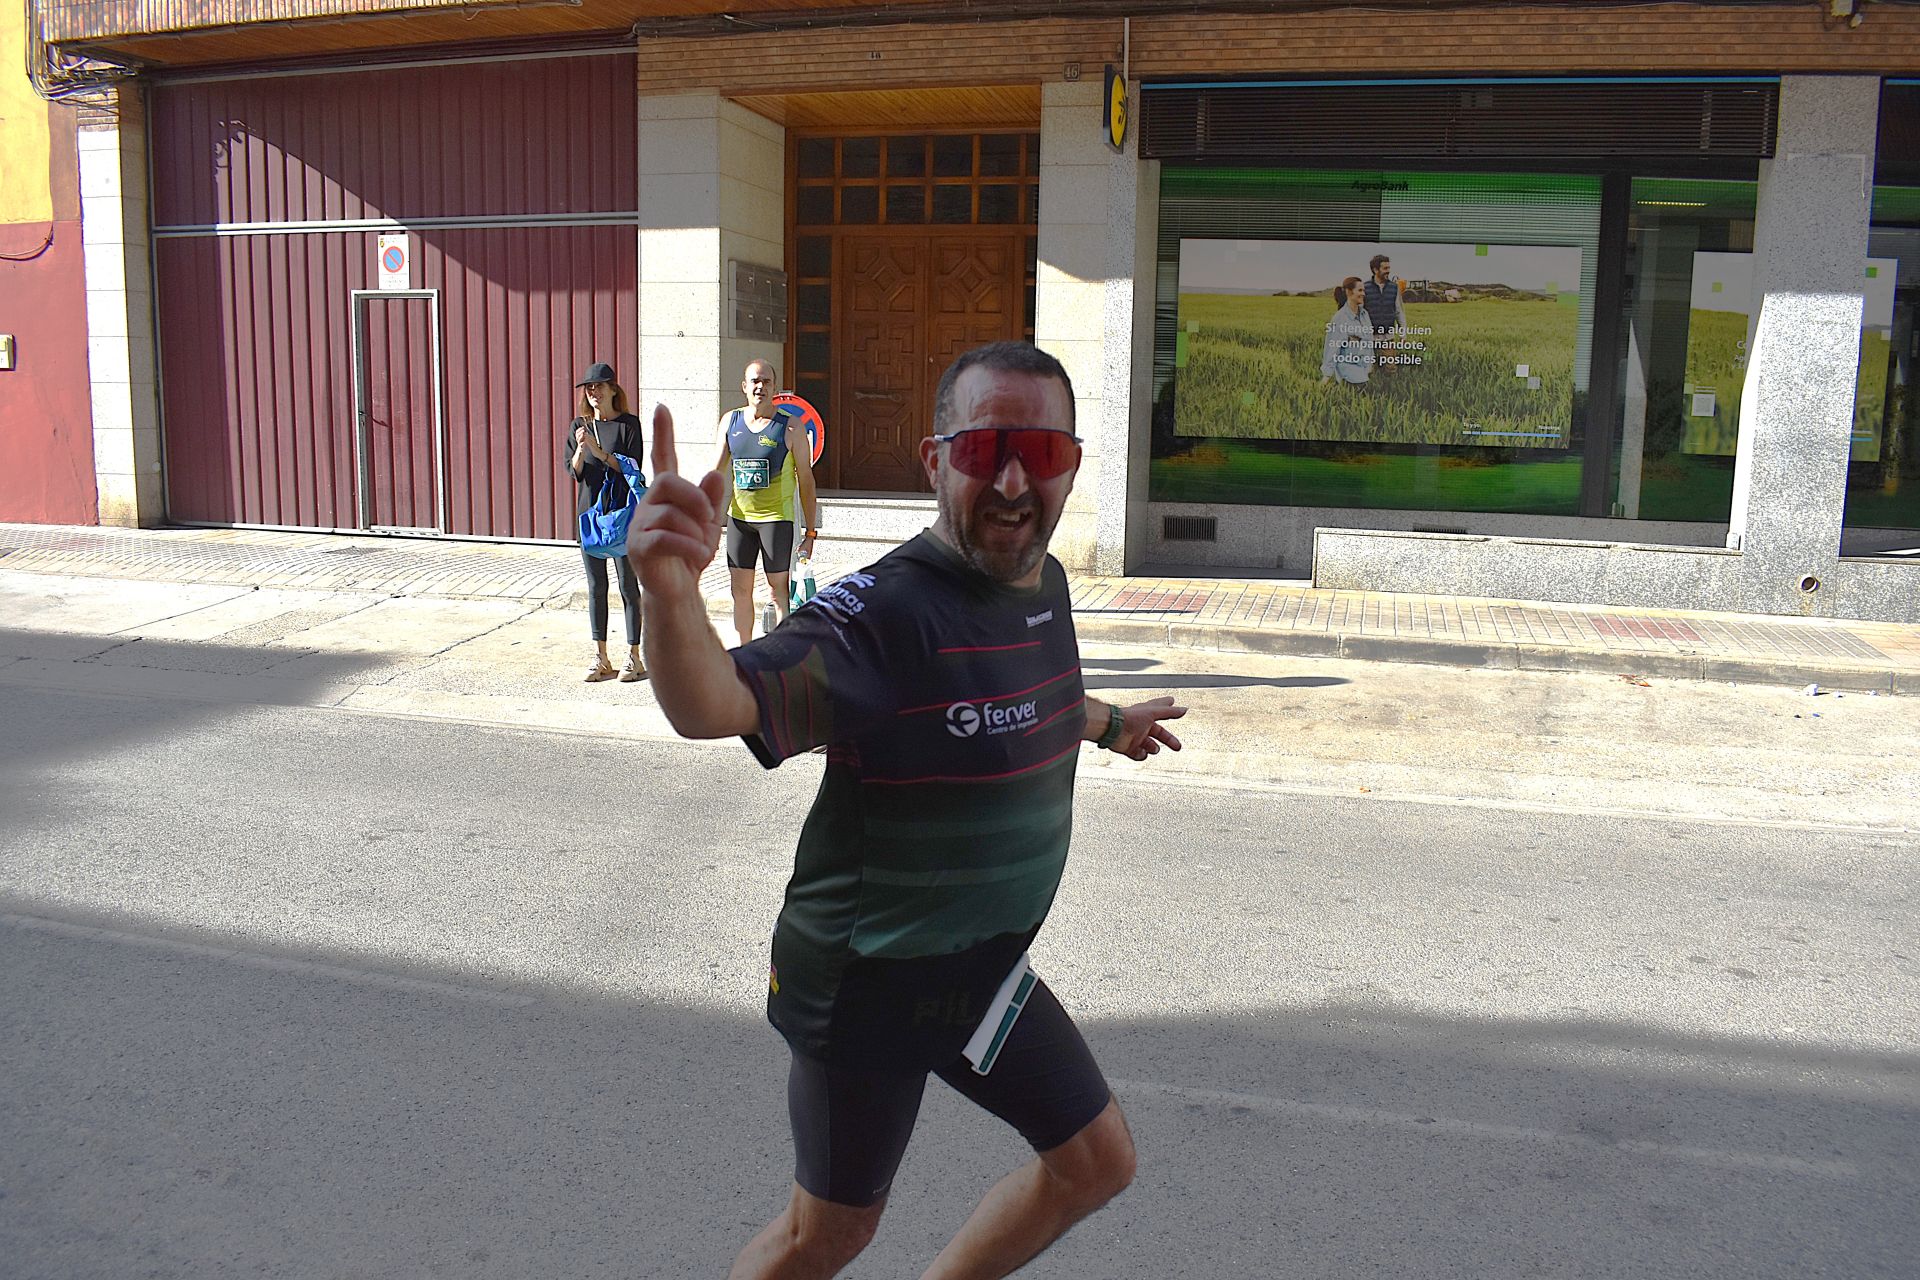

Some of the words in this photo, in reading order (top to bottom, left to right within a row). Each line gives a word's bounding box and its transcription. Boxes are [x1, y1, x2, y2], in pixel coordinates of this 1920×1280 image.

[1064, 65, 1078, 79] 46
[1325, 322, 1336, 333] Si
[1339, 323, 1375, 334] tienes
[1377, 326, 1385, 334] a
[1388, 324, 1432, 338] alguien
[1328, 338, 1427, 351] acompañándote,
[1333, 353, 1361, 364] todo
[1363, 355, 1376, 364] es
[1379, 353, 1422, 366] posible
[739, 471, 763, 484] 176
[983, 700, 1037, 726] ferver
